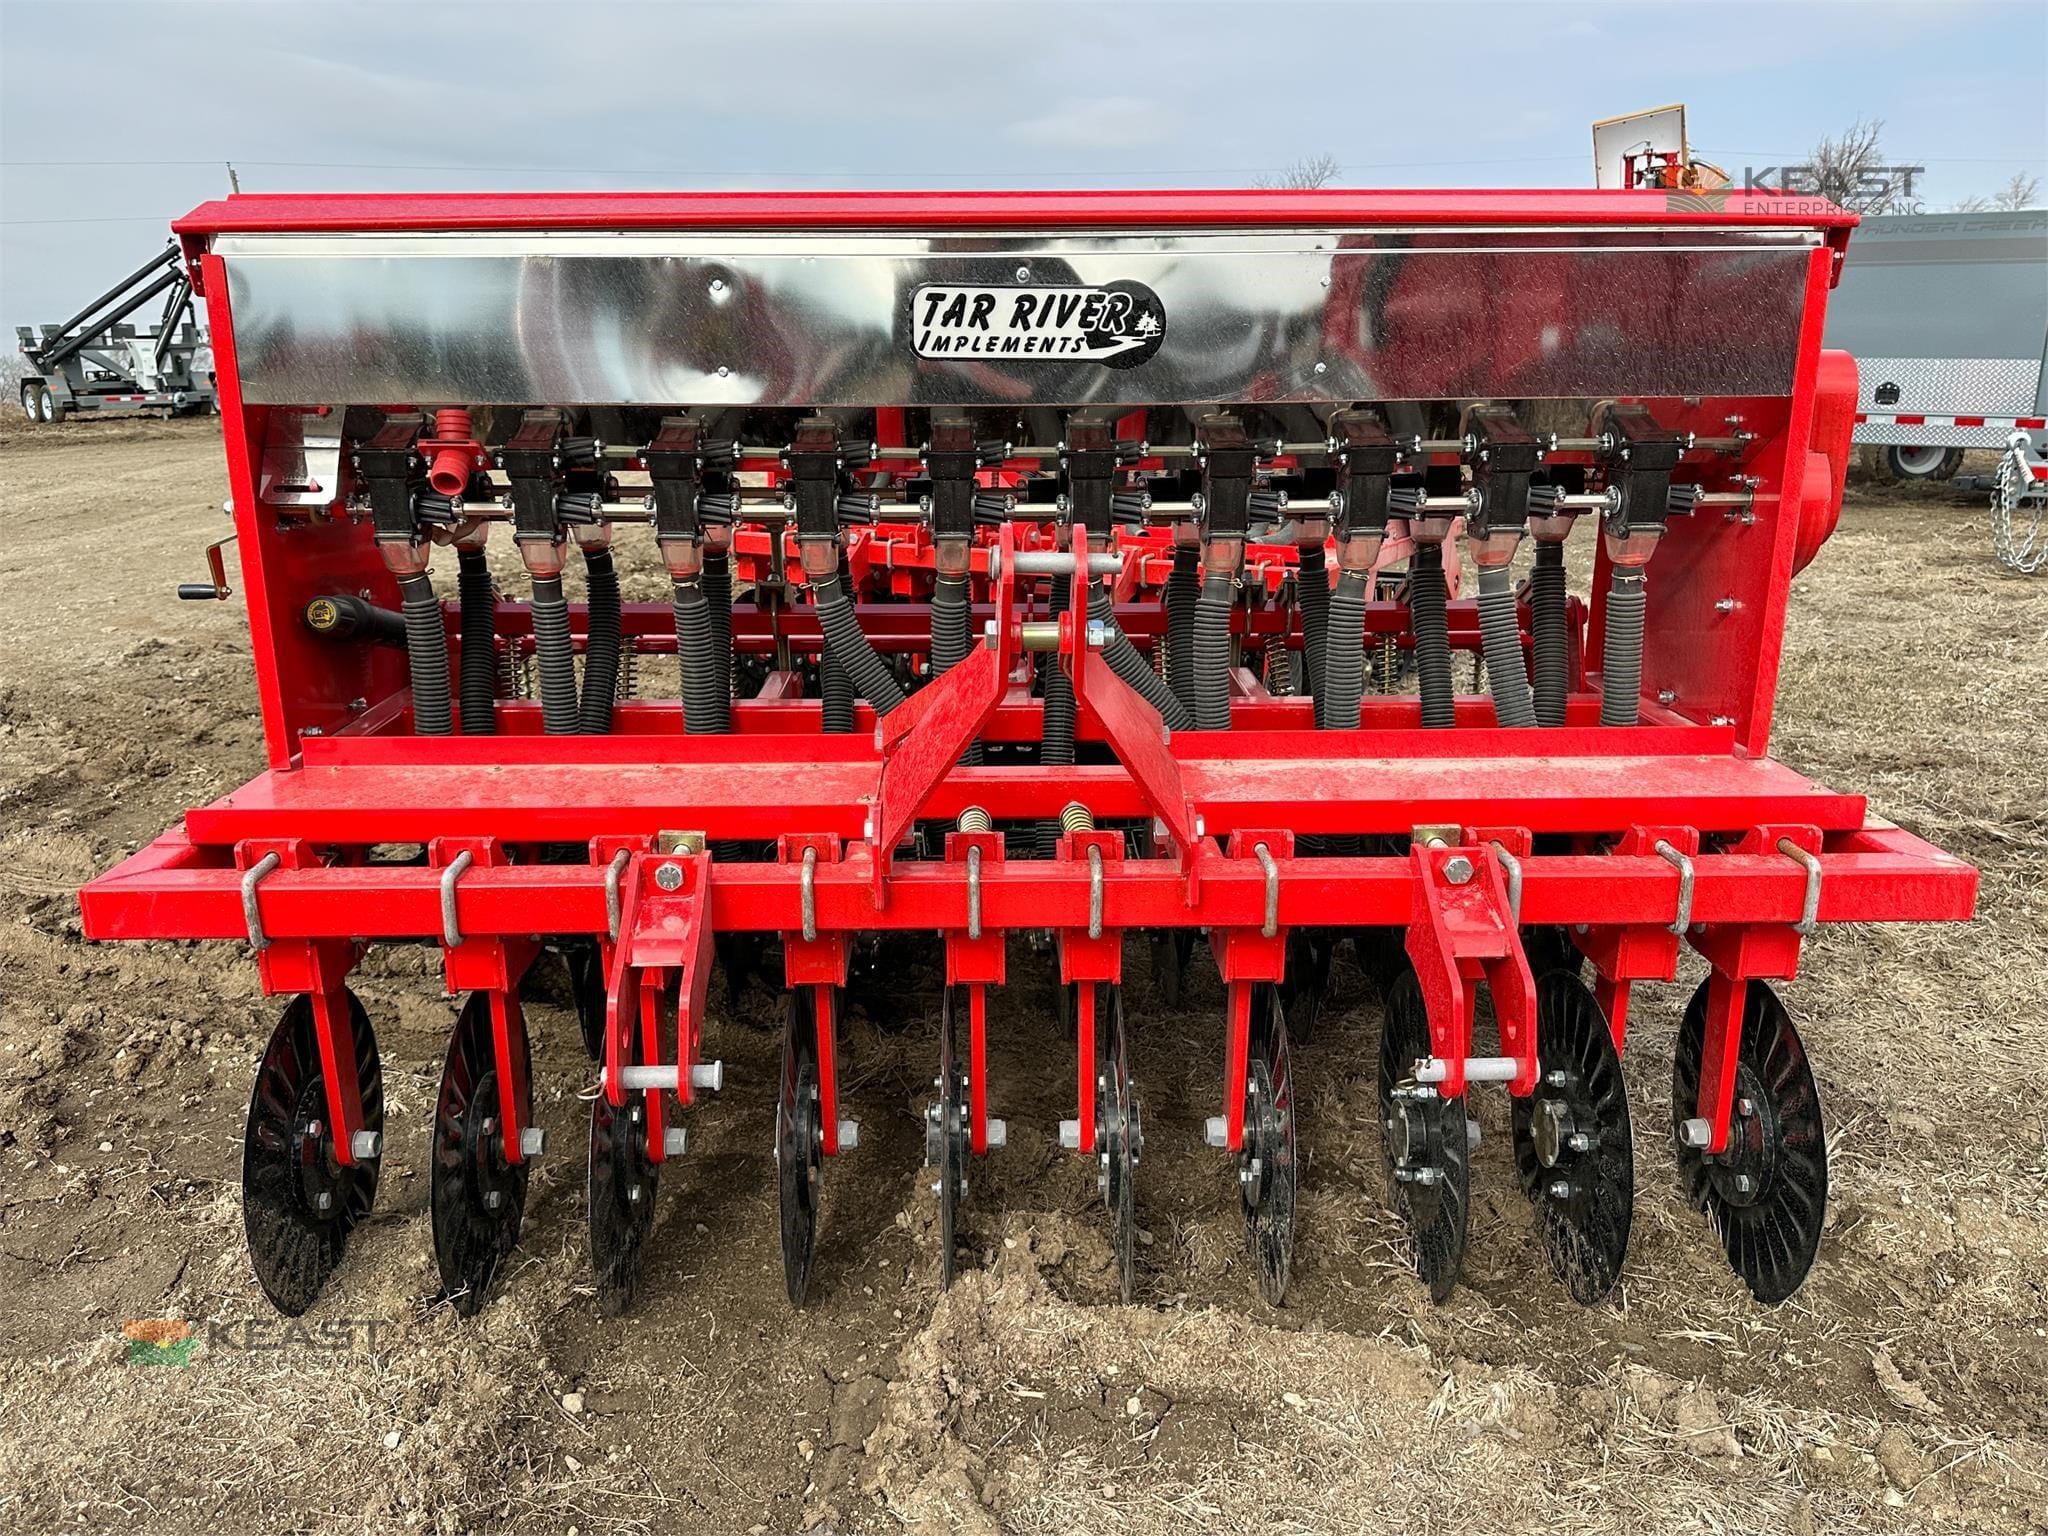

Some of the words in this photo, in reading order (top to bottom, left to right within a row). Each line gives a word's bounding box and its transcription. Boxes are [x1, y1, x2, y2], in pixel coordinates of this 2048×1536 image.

[922, 292, 996, 331] TAR
[1009, 293, 1131, 333] RIVER
[918, 330, 1086, 353] IMPLEMENTS
